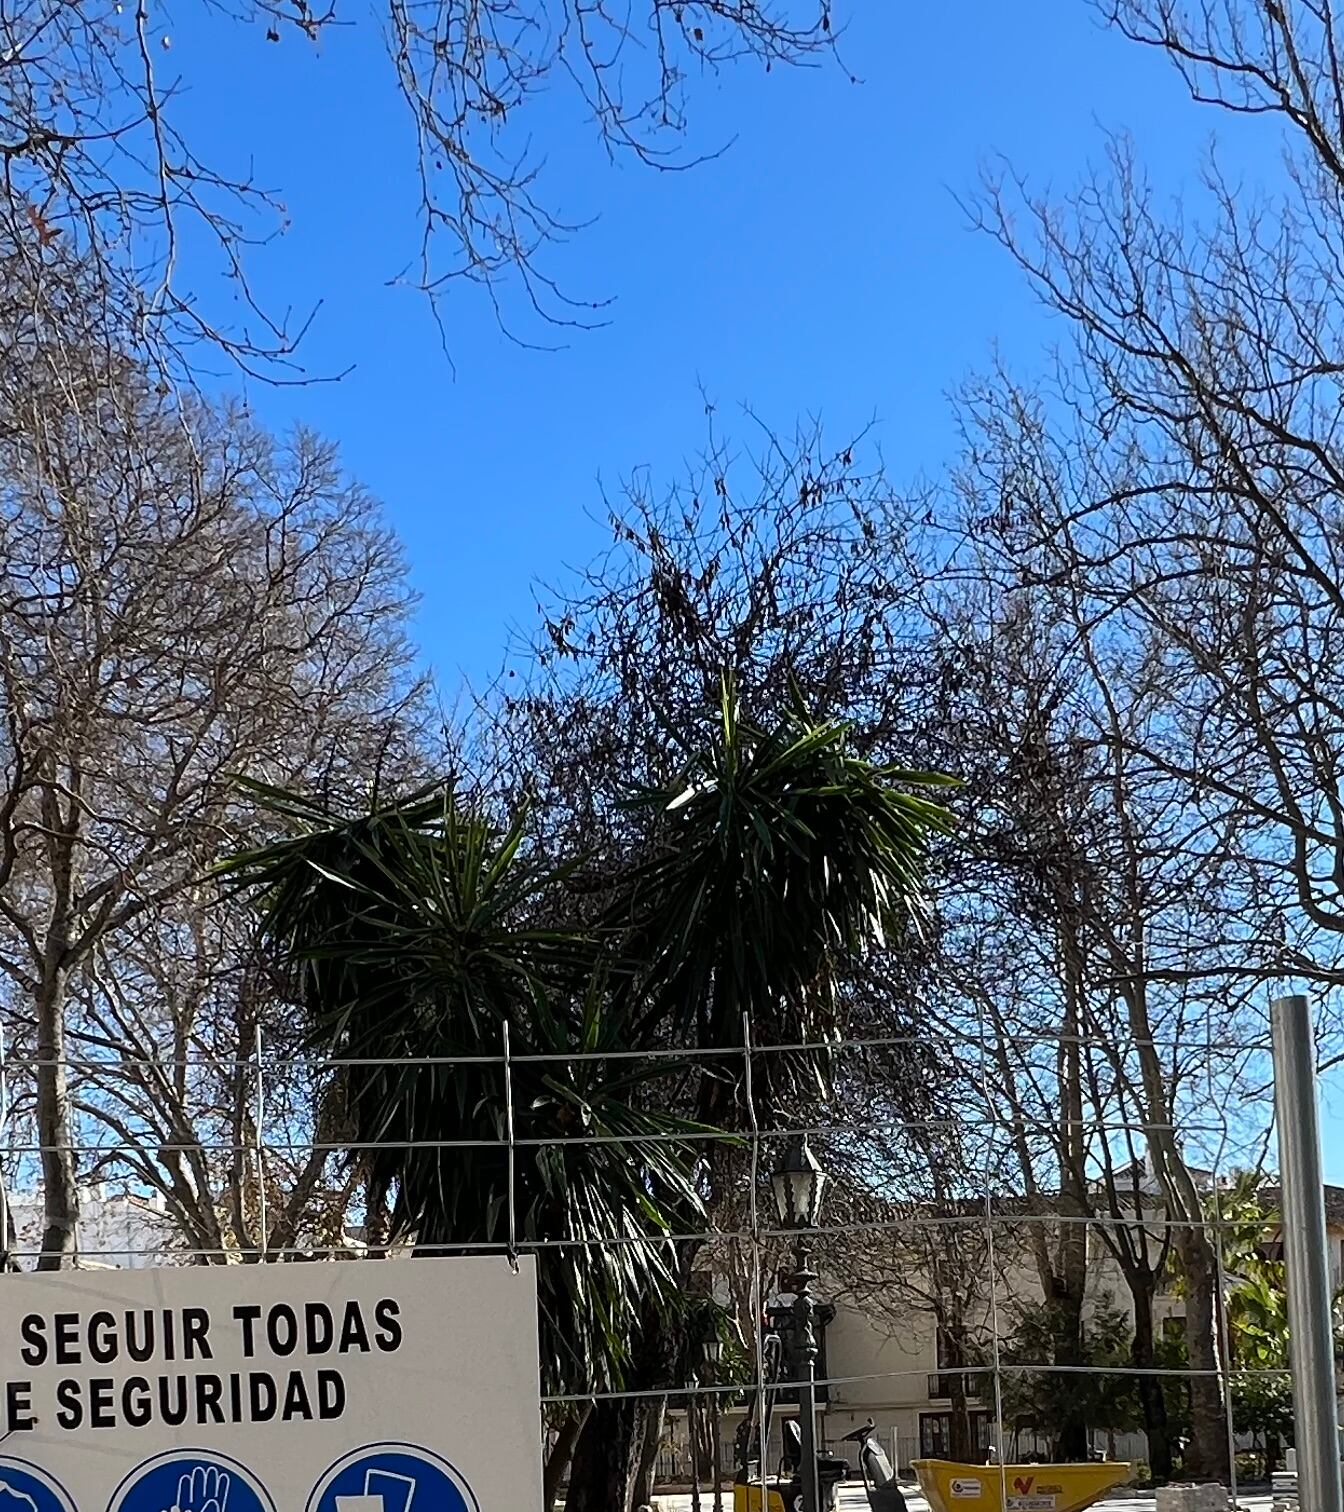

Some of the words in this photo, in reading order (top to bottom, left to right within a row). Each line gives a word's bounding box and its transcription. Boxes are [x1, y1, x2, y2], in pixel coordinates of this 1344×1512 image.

[21, 1308, 213, 1366] SEGUIR
[233, 1299, 403, 1358] TODAS
[56, 1369, 346, 1430] SEGURIDAD
